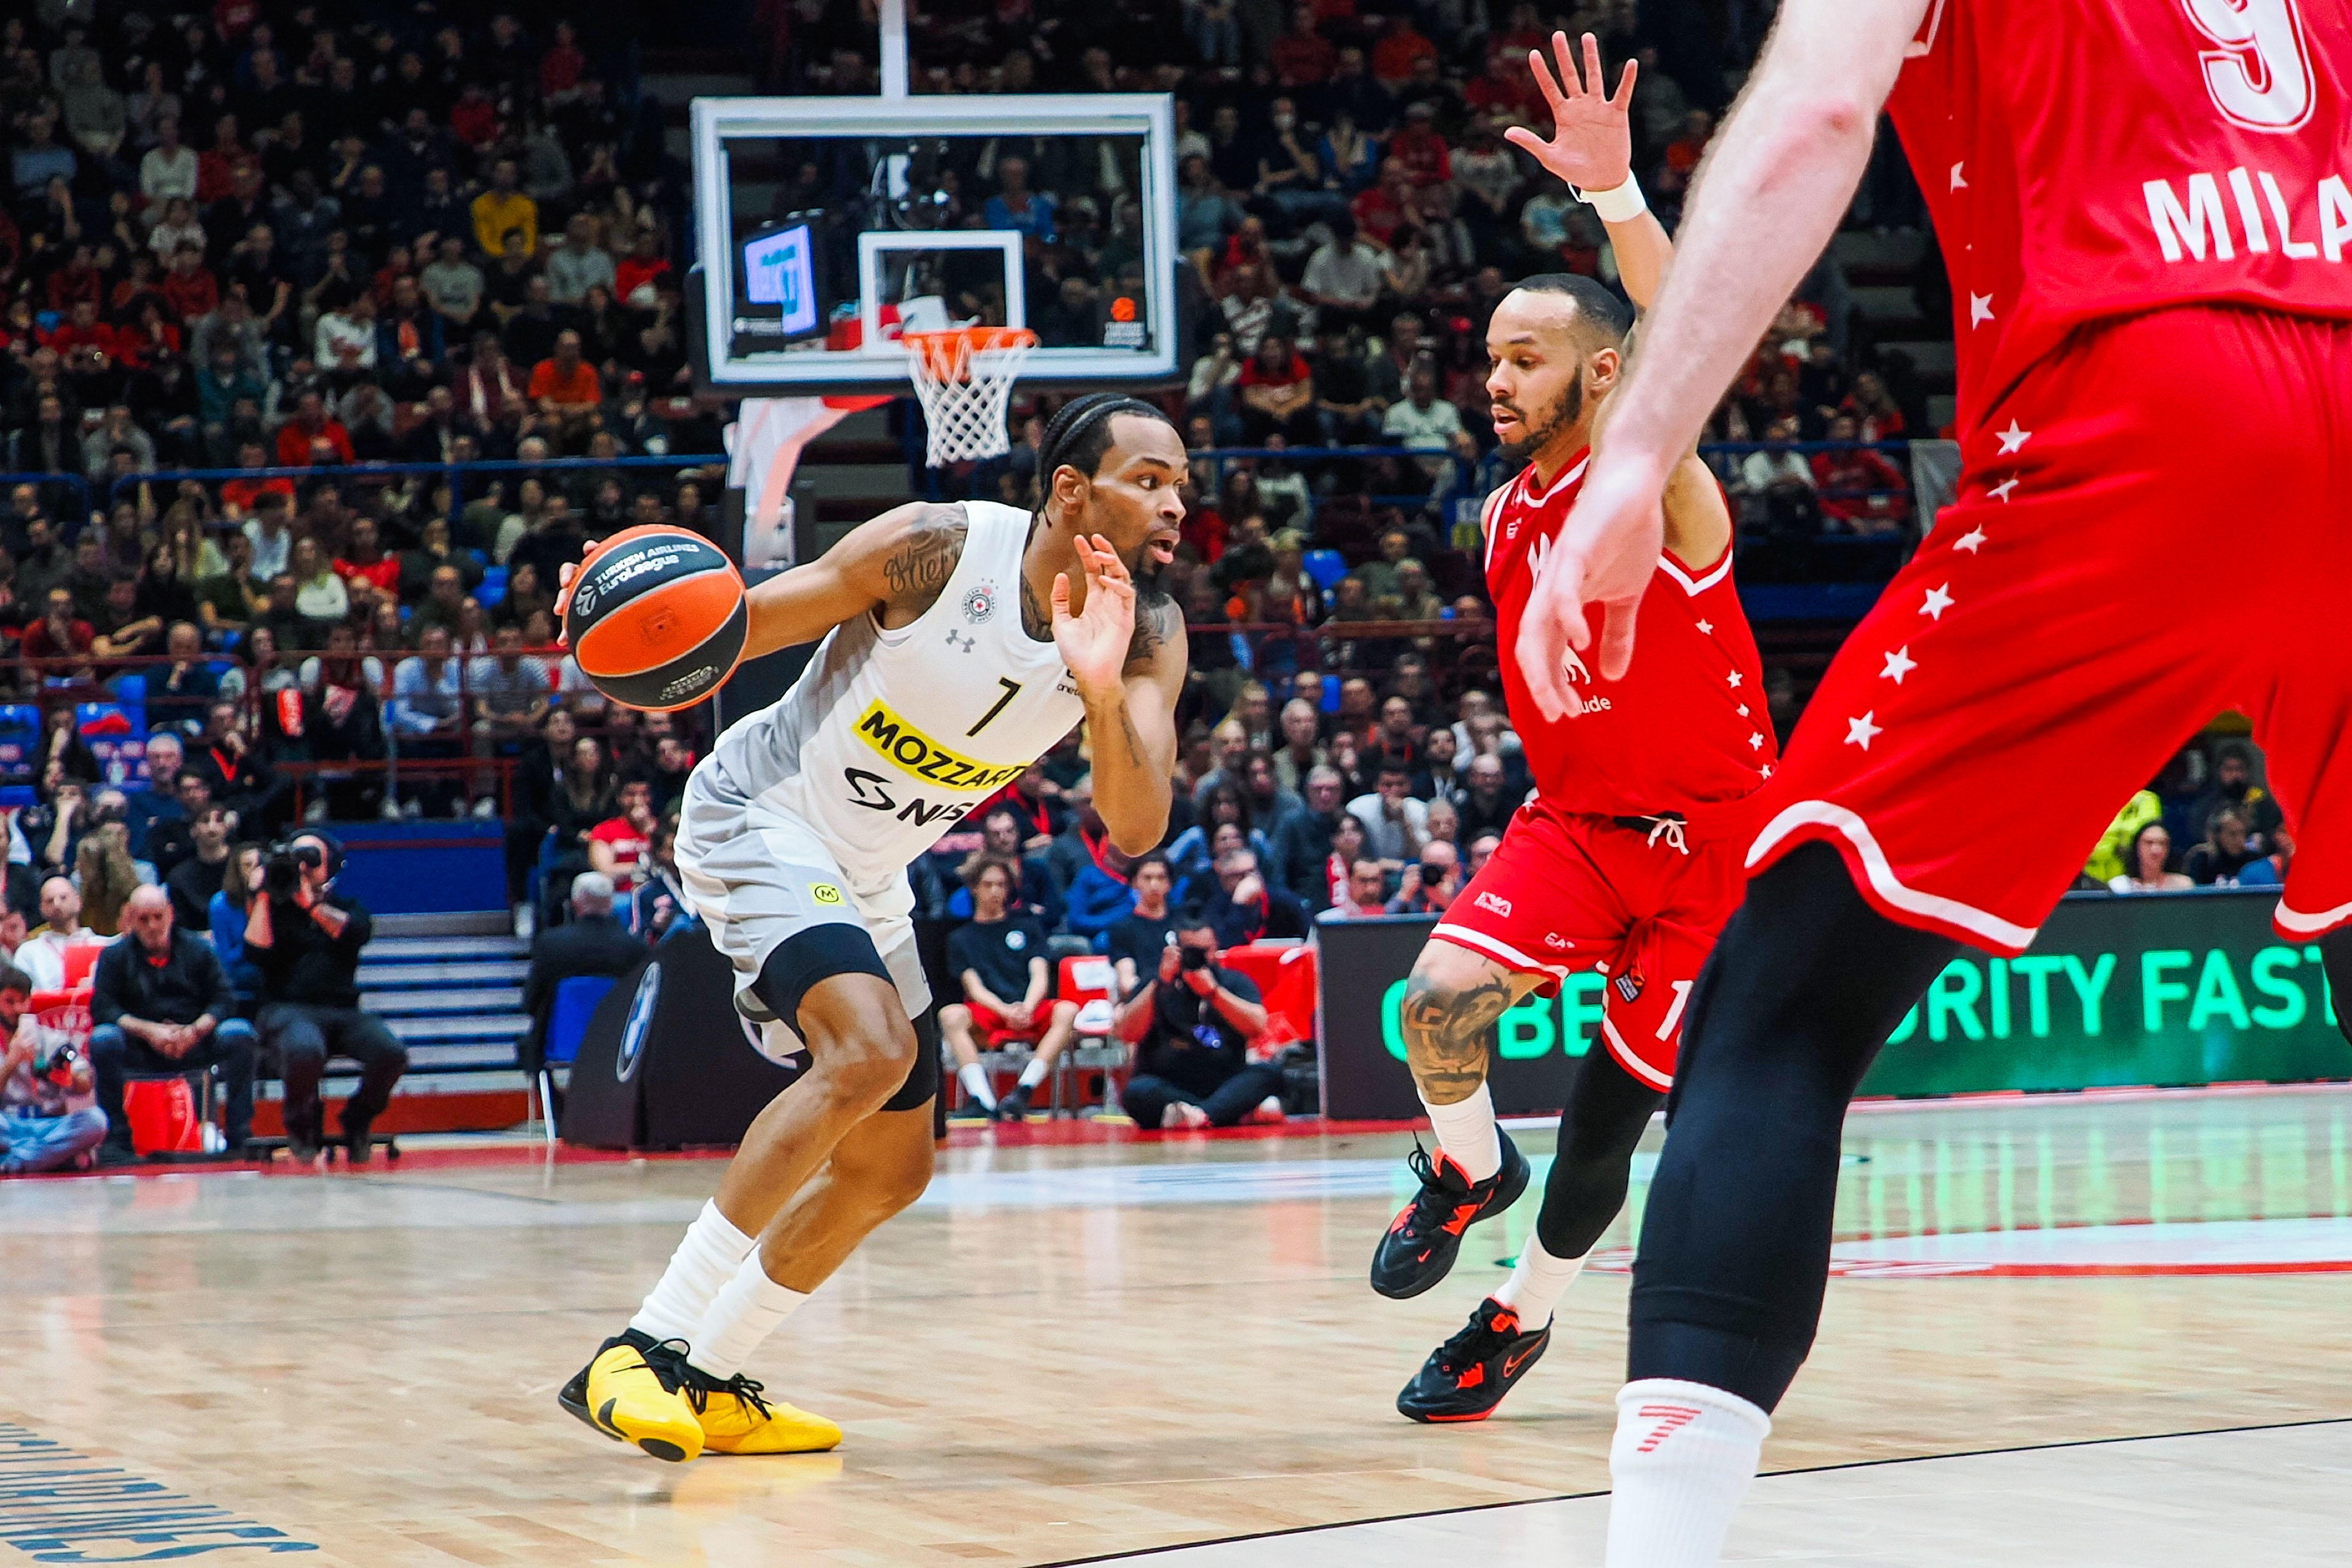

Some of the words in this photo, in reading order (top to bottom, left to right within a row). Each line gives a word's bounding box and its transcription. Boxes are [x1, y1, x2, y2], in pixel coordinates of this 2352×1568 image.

[2180, 0, 2316, 134] 9
[2142, 167, 2352, 263] MILA
[595, 551, 646, 584] TURKISH
[647, 543, 699, 557] AIRLINES
[966, 676, 1021, 737] 7
[897, 798, 975, 827] NIS
[1381, 971, 1607, 1063] CBE
